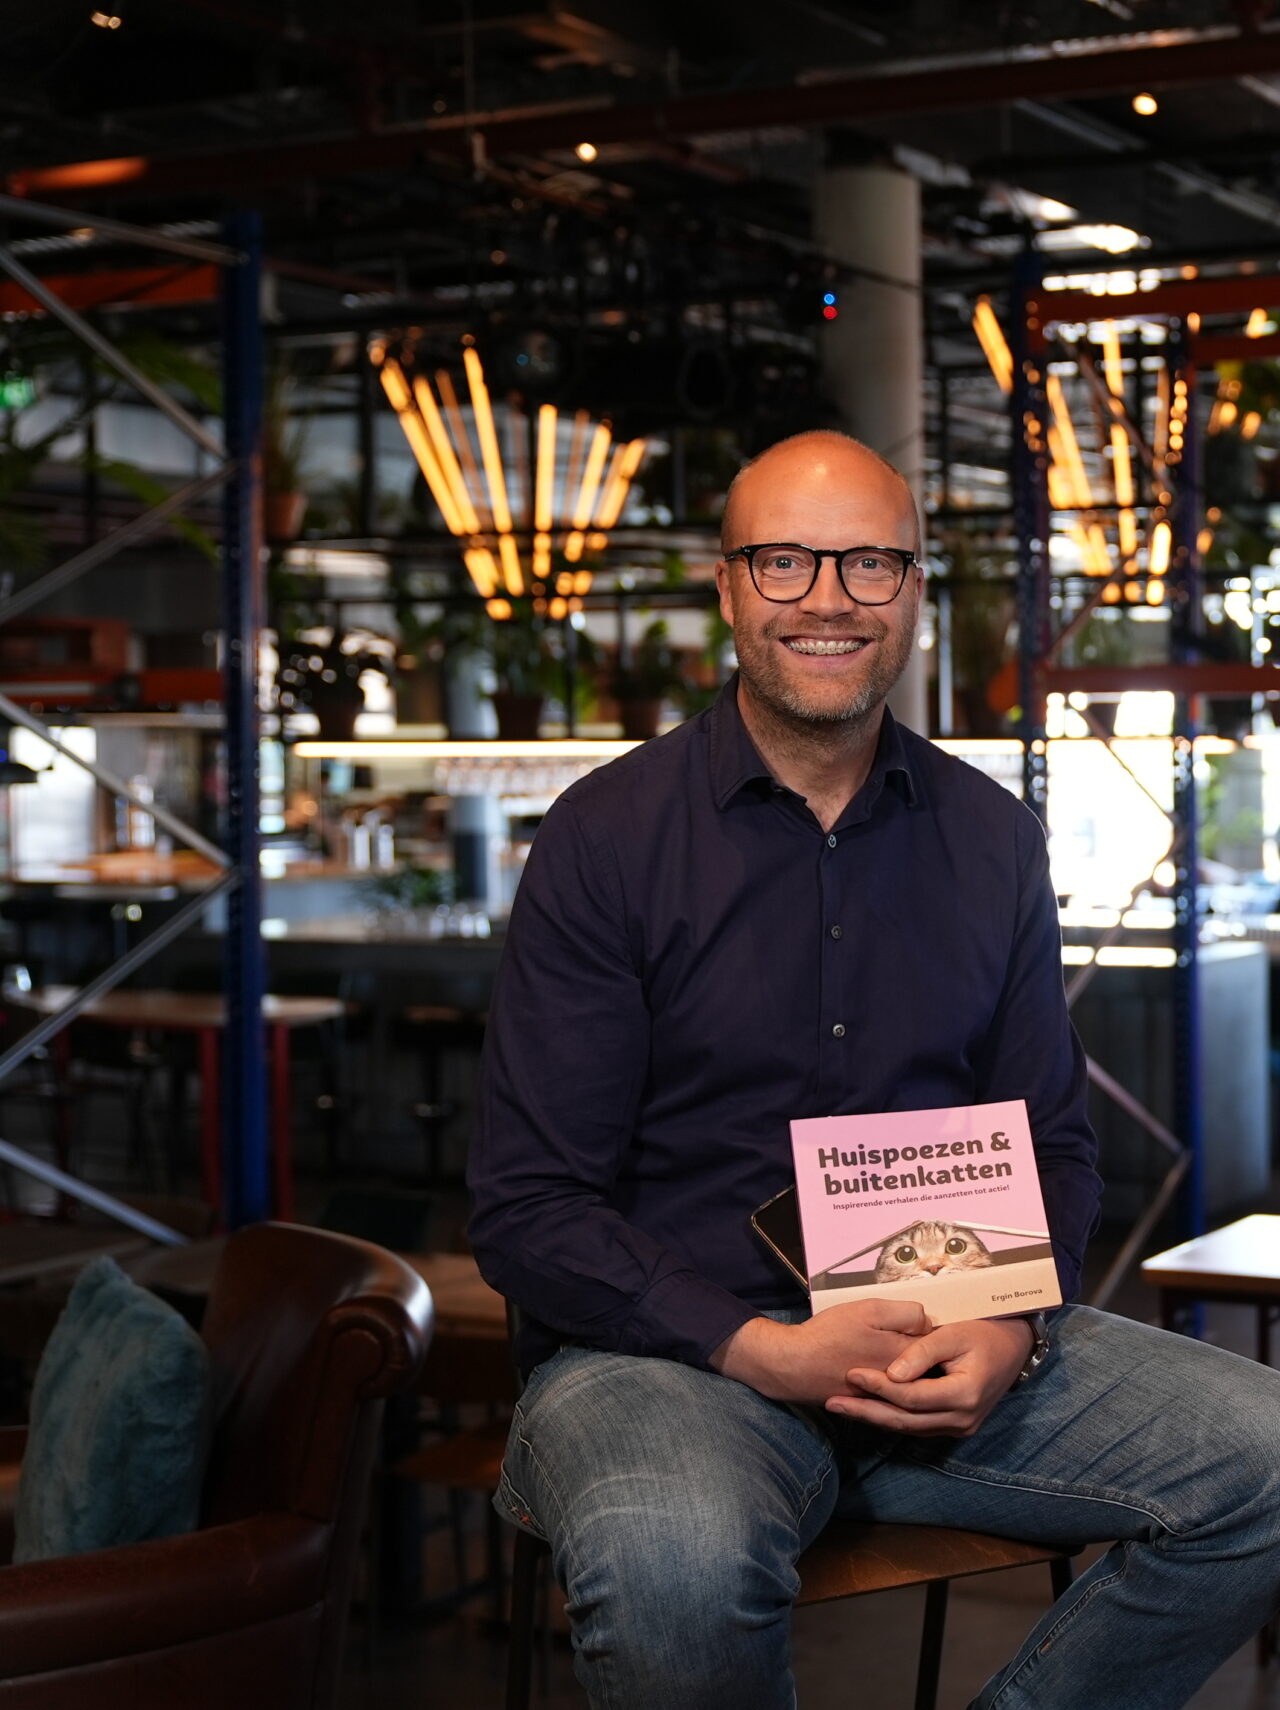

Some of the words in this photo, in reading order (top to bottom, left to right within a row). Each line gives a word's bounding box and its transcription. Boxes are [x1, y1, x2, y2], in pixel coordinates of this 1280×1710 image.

[818, 1138, 984, 1169] Huispoezen
[990, 1131, 1012, 1151] &
[824, 1161, 1012, 1196] buitenkatten
[833, 1200, 883, 1211] Inspirerende
[884, 1197, 919, 1205] verhalen
[934, 1190, 973, 1200] aanzetten
[988, 1184, 1010, 1193] actie!
[991, 1293, 1013, 1302] Ergin
[1014, 1289, 1043, 1298] Borova
